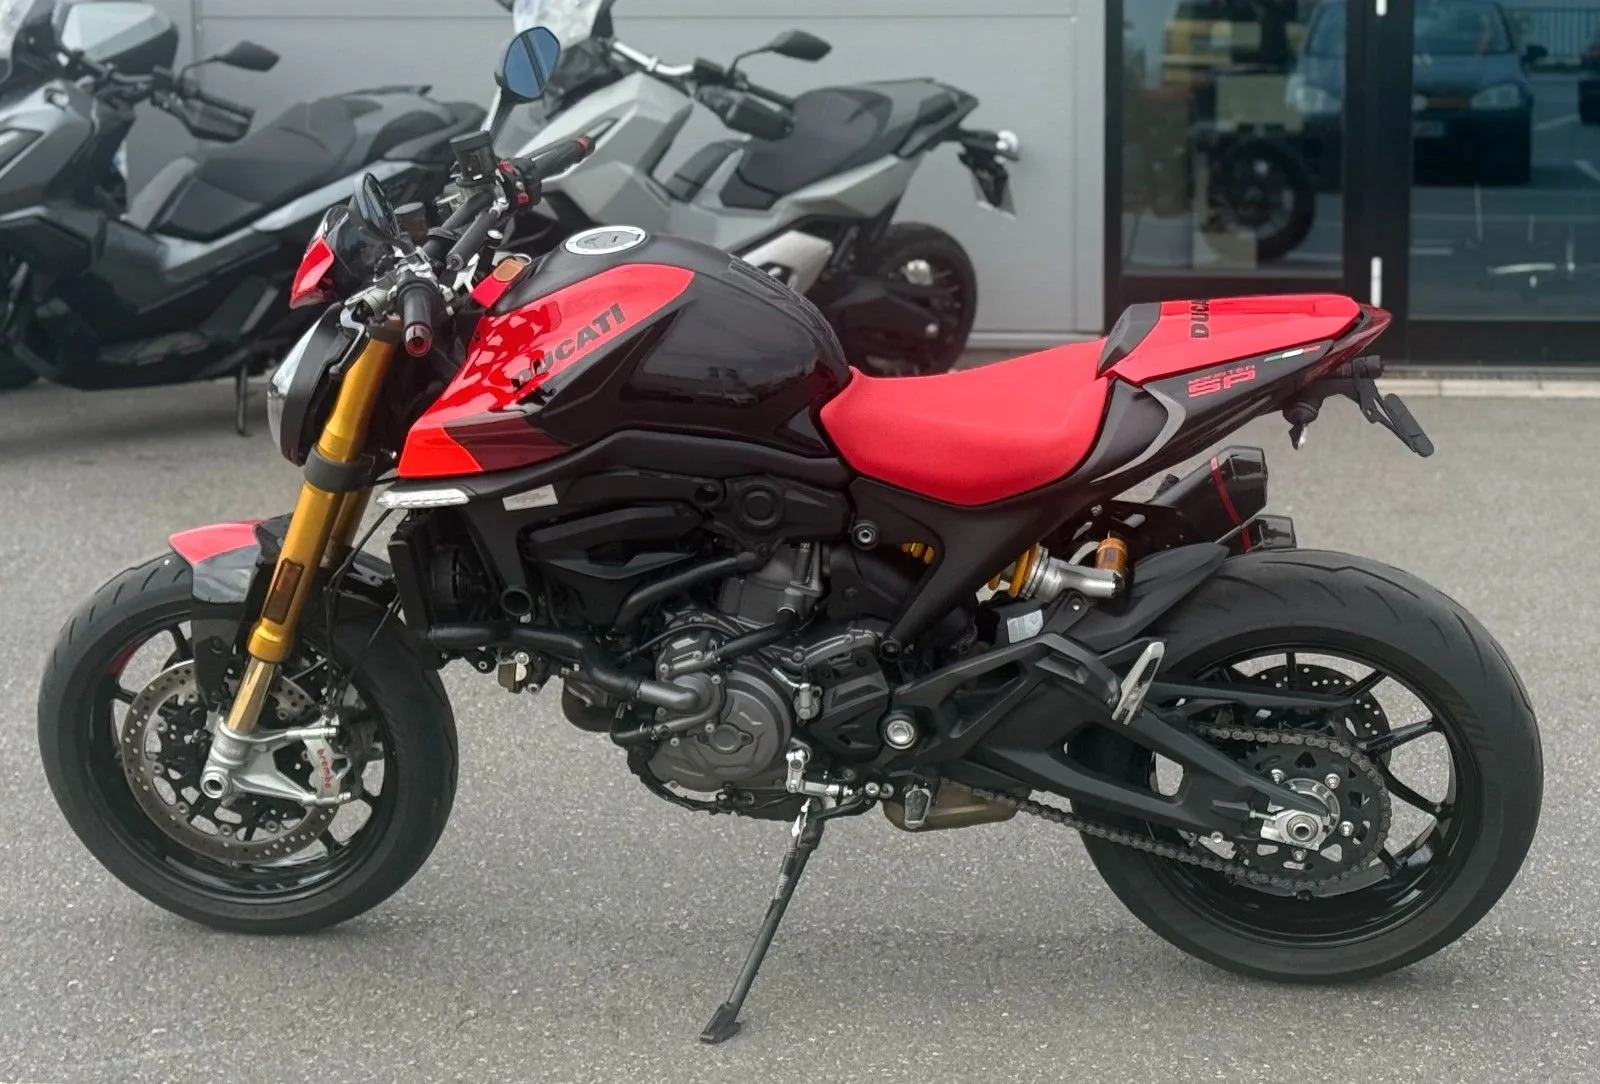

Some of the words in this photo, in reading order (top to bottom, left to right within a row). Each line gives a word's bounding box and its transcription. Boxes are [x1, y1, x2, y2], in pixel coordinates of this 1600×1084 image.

[511, 303, 626, 391] DUCATI
[1188, 369, 1256, 398] SP
[316, 747, 334, 789] brembo
